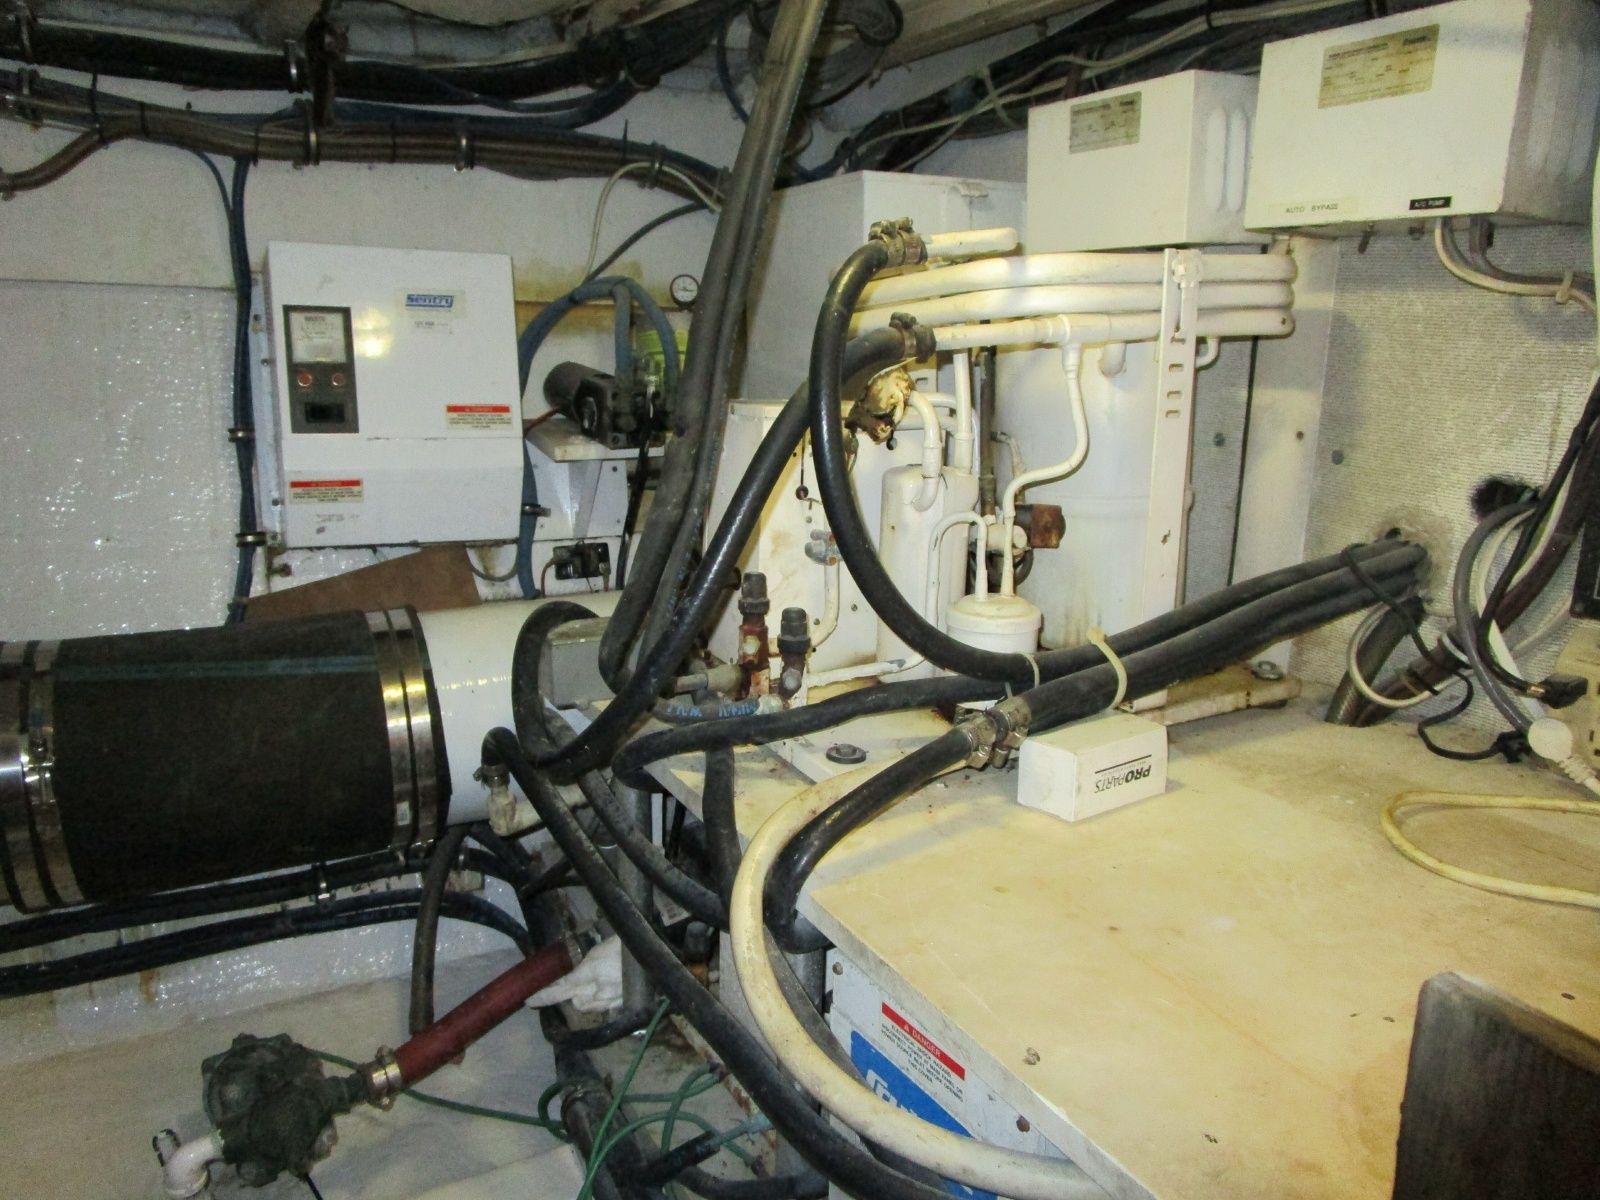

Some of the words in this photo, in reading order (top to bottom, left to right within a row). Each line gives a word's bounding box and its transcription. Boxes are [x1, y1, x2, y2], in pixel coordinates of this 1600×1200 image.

[1311, 203, 1338, 211] BYPASS
[406, 294, 454, 308] Sentry
[1094, 764, 1152, 794] PROPARTS
[881, 1028, 896, 1044] POWER
[891, 1024, 915, 1048] ELECTRICAL
[917, 1046, 932, 1061] SHOCK
[912, 1029, 941, 1058] DANGER
[907, 1045, 923, 1060] POWER
[929, 1063, 941, 1075] MAIN
